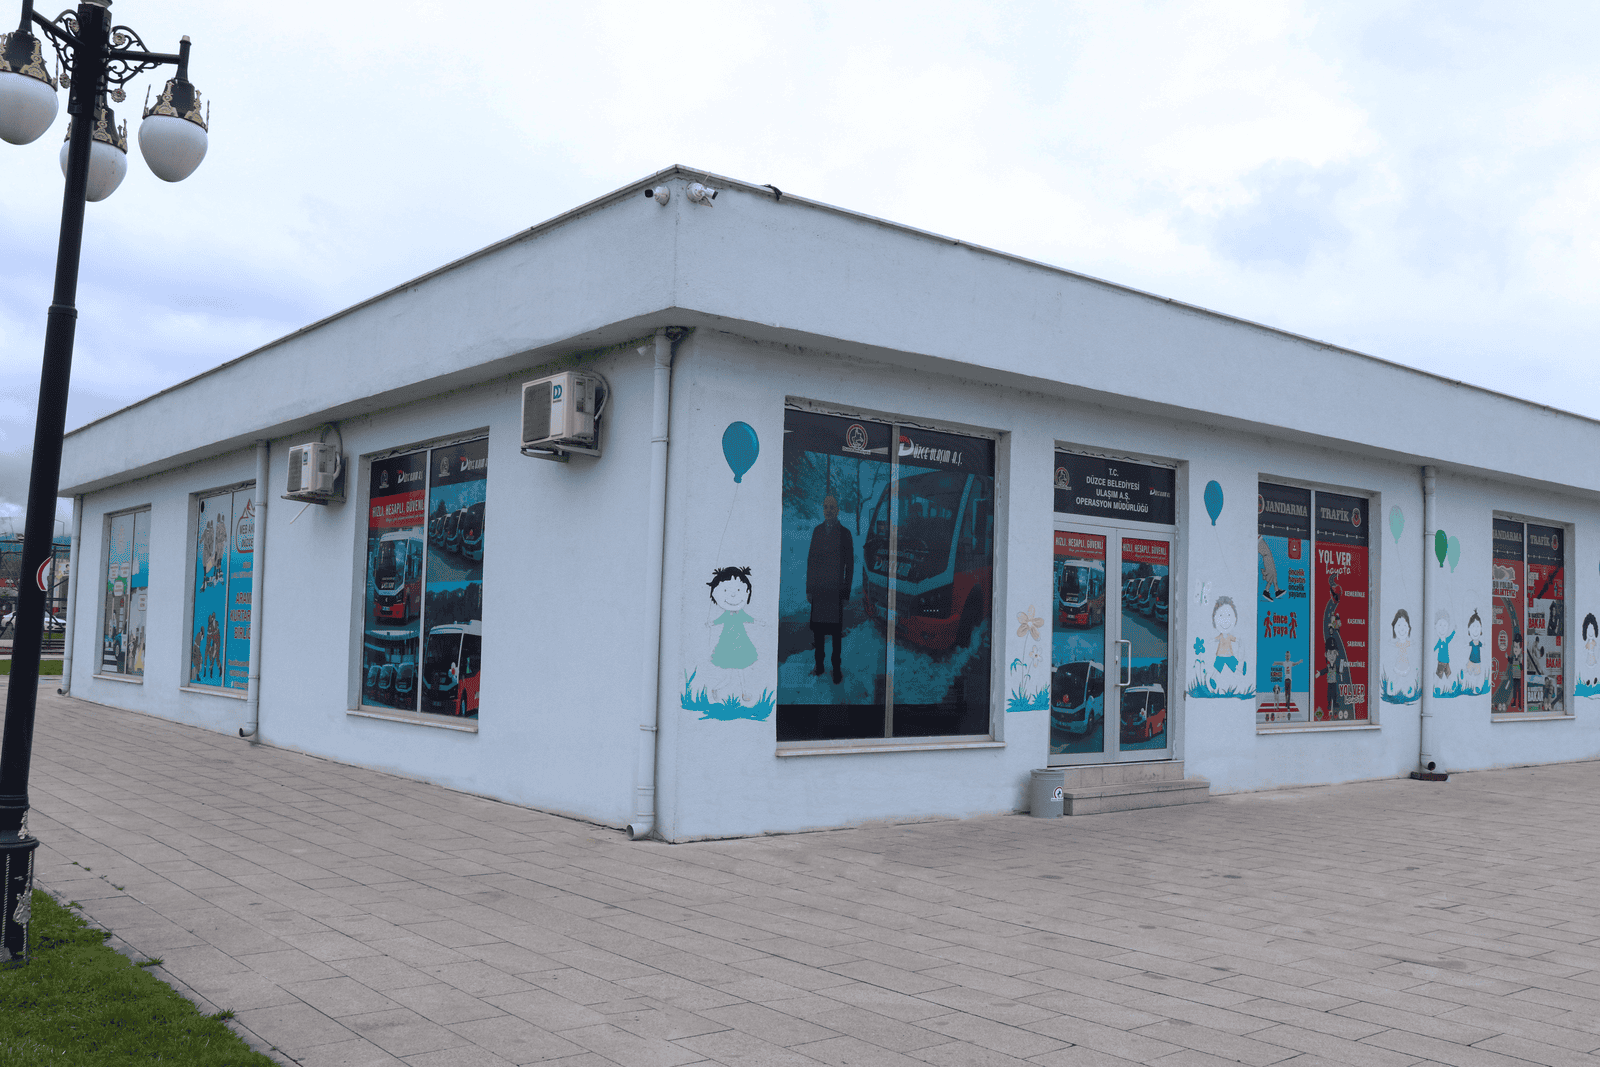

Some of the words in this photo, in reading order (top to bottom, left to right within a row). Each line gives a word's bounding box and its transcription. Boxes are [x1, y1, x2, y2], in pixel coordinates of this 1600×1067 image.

[1108, 467, 1119, 477] T.C.
[1086, 475, 1106, 486] DÜZCE
[1107, 479, 1140, 491] BELEDİYESİ
[1095, 488, 1118, 500] ULAŞIM
[1119, 491, 1131, 502] A.Ş.
[1075, 496, 1112, 509] OPERASYON
[1113, 500, 1149, 513] MÜDÜRLÜĞÜ
[1265, 500, 1308, 517] JANDARMA
[1320, 507, 1350, 522] TRAFİK
[1318, 549, 1334, 565] YOL
[1336, 551, 1351, 566] VER
